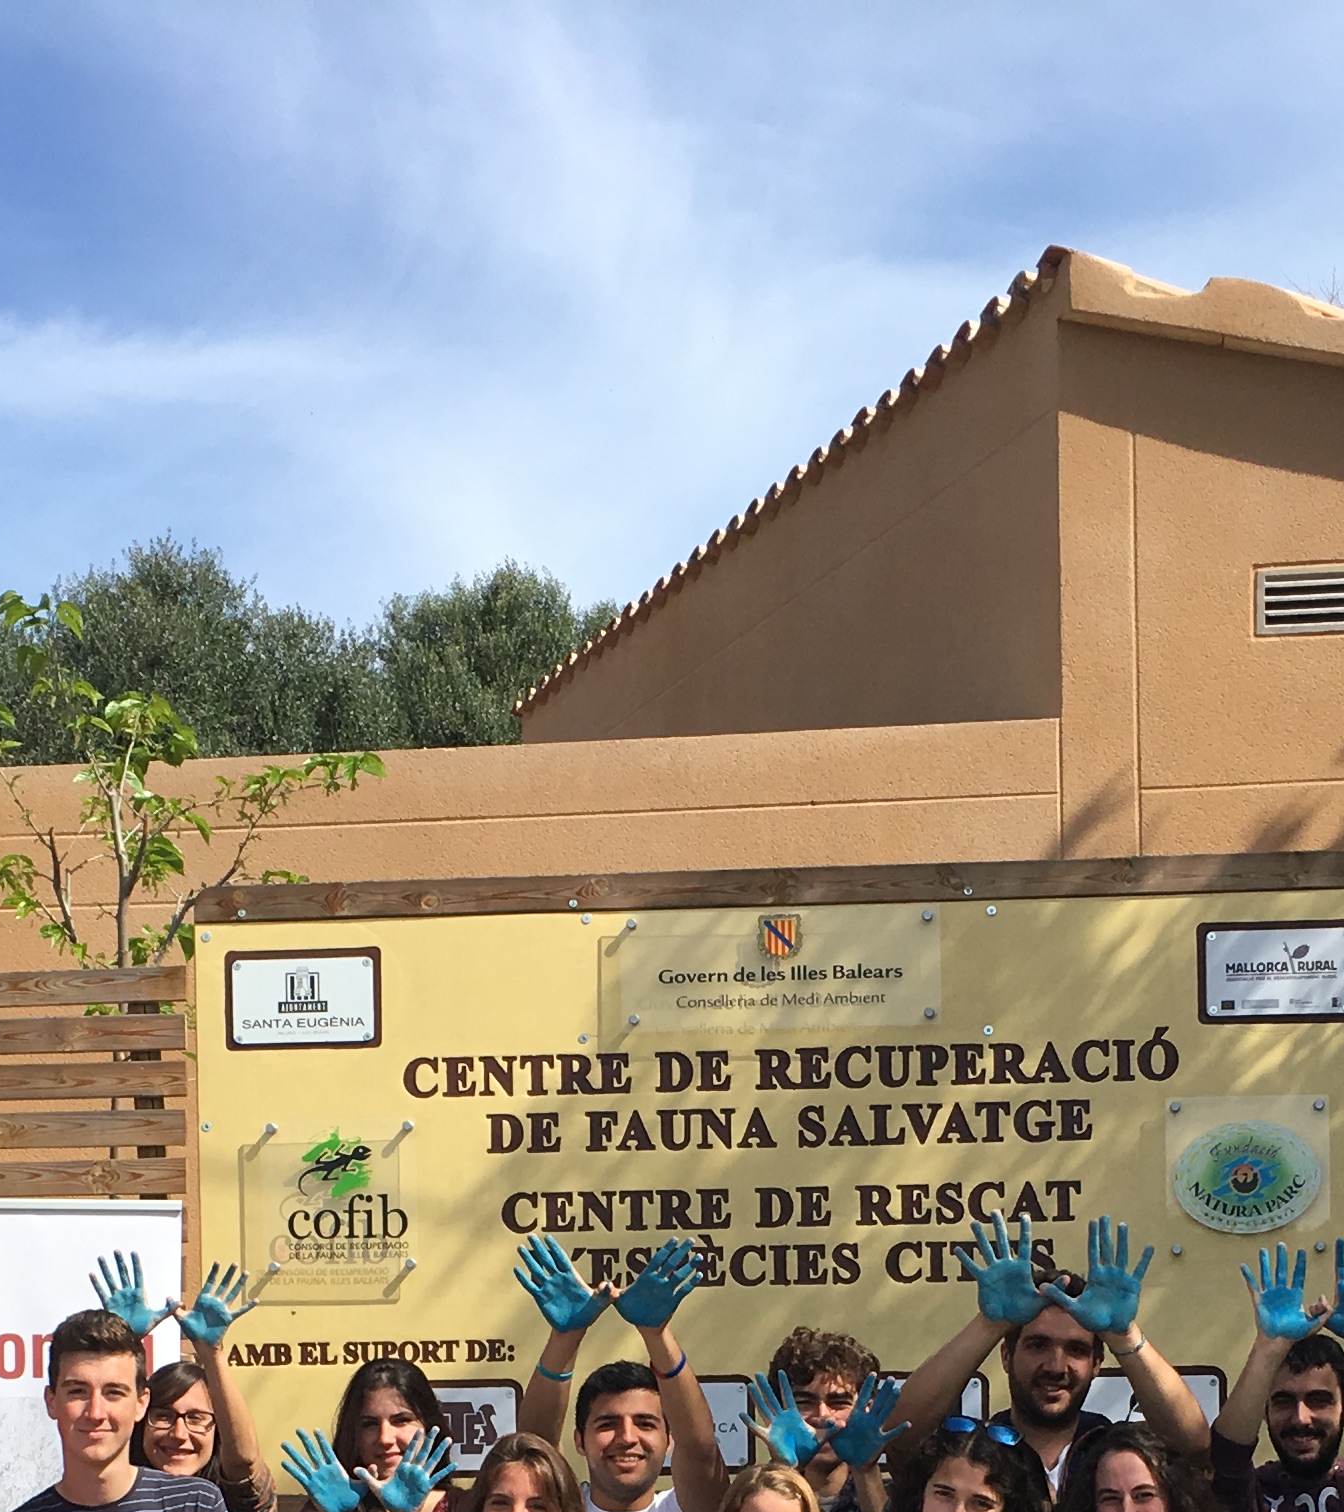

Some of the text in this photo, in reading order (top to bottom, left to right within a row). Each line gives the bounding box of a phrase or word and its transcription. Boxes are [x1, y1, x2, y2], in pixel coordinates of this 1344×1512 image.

[658, 963, 903, 985] Govern de les Illes Balears
[1225, 960, 1338, 974] MALLORCA RURAL
[676, 990, 886, 1009] Conselleria de Medi Ambient
[242, 1015, 365, 1029] SANTA EUGÈNIA
[403, 1027, 1179, 1098] CENTRE DE RECUPERACIÓ
[487, 1099, 1093, 1155] DE FAUNA SALVATGE
[288, 1194, 409, 1240] cofib
[502, 1180, 1081, 1234] CENTRE DE RESCAT
[1189, 1181, 1262, 1217] NATURA
[1265, 1174, 1306, 1214] PARC
[885, 1239, 1056, 1283] CITS
[227, 1339, 515, 1367] AMB EL SUPORT DE:
